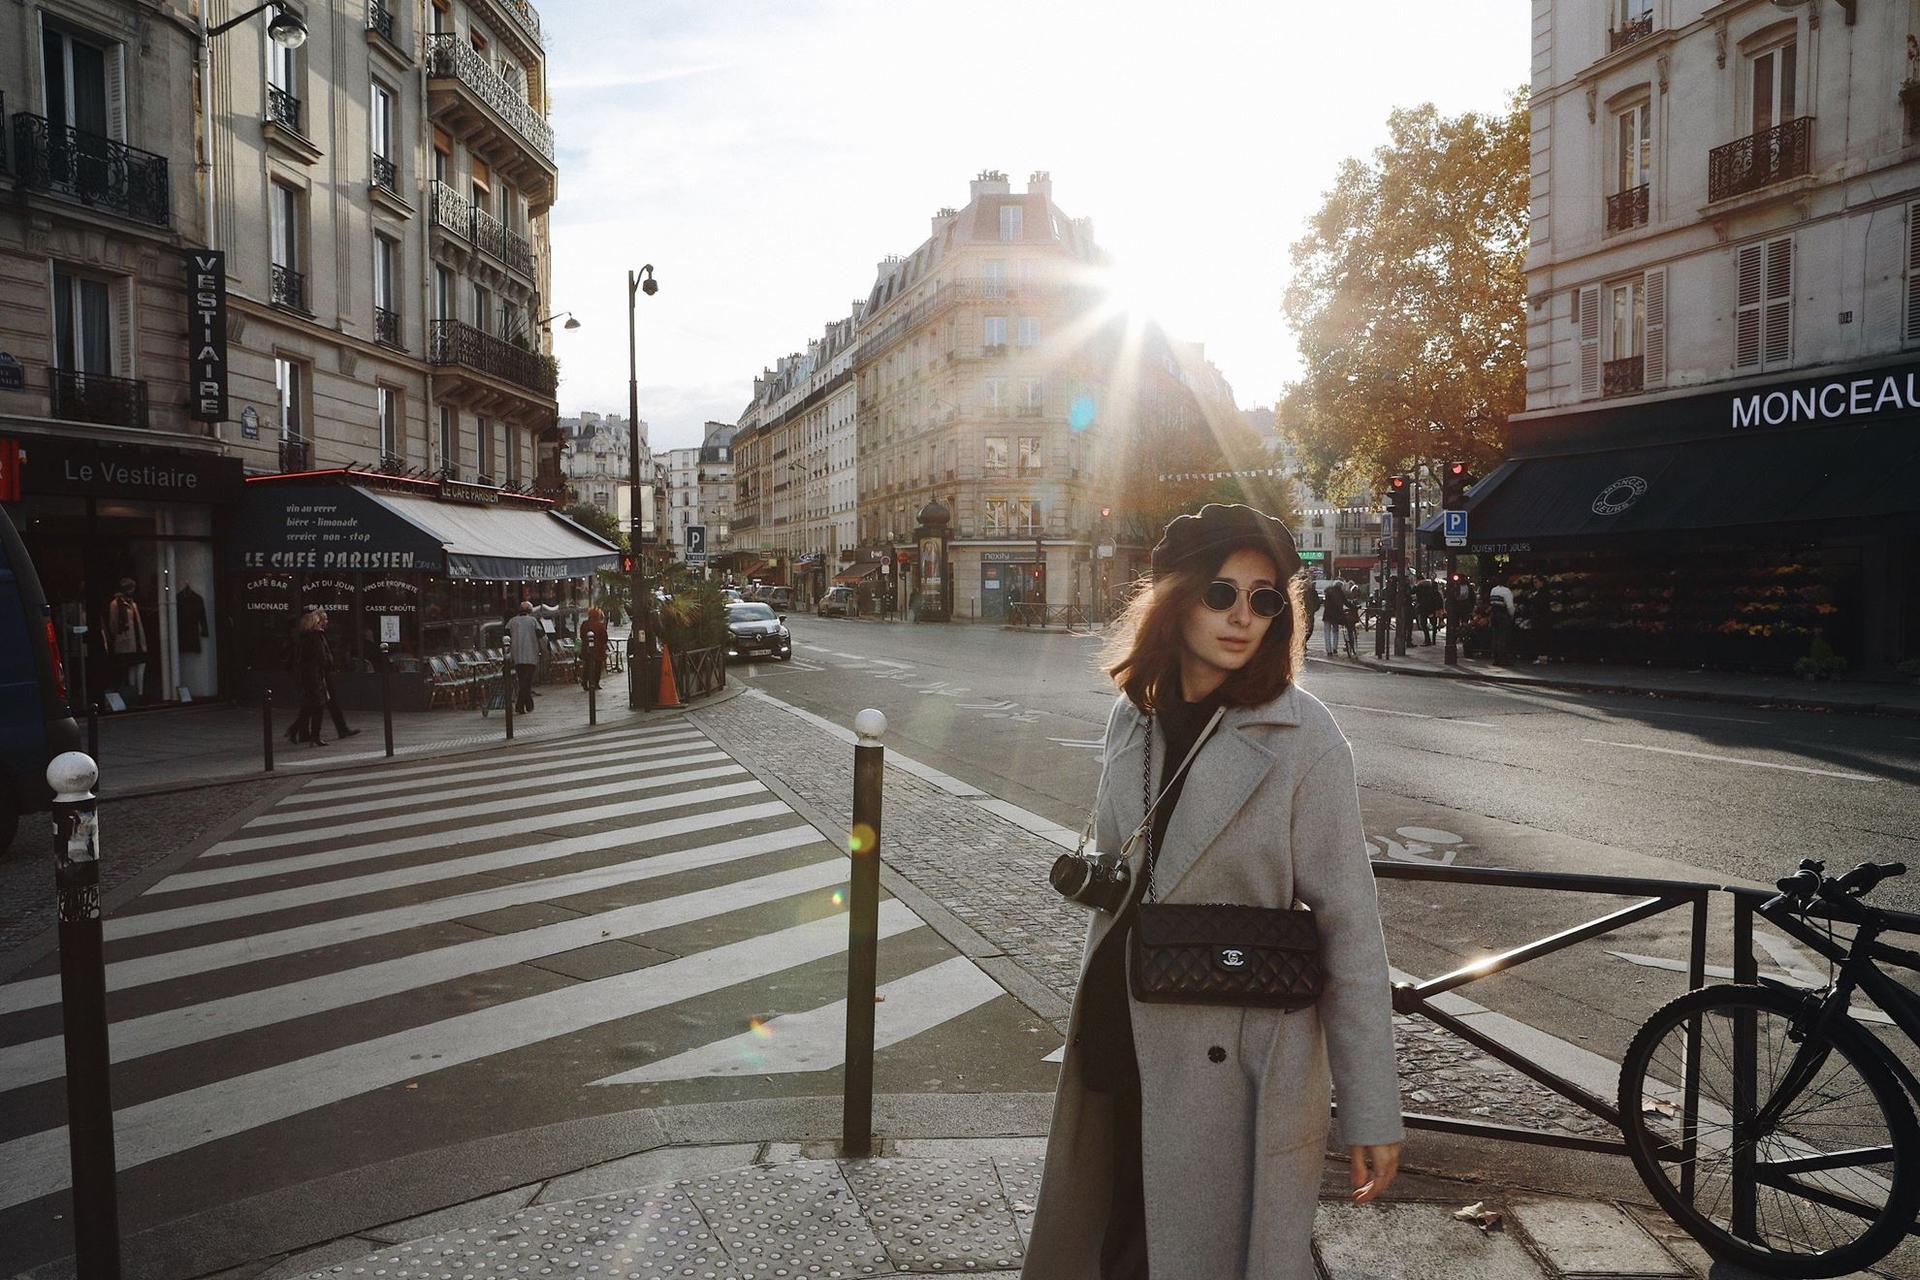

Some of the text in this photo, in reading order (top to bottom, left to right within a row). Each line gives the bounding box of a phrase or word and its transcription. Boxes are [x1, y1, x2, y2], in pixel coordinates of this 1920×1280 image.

[195, 256, 220, 414] VESTIAIRE
[65, 459, 197, 488] Le Vestiaire
[441, 484, 451, 497] LE
[286, 504, 337, 513] vin au verre
[317, 517, 358, 527] limonade
[286, 531, 317, 541] service
[322, 533, 341, 541] non
[349, 532, 371, 543] stop
[1472, 544, 1496, 553] OUVERT
[1509, 542, 1531, 552] JOURS
[245, 552, 265, 568] LE
[271, 548, 317, 568] CAFÉ
[324, 551, 415, 569] PARISIEN
[522, 564, 529, 577] LE
[270, 579, 288, 591] BAR
[302, 581, 321, 592] PLAT
[334, 581, 355, 592] JOUR
